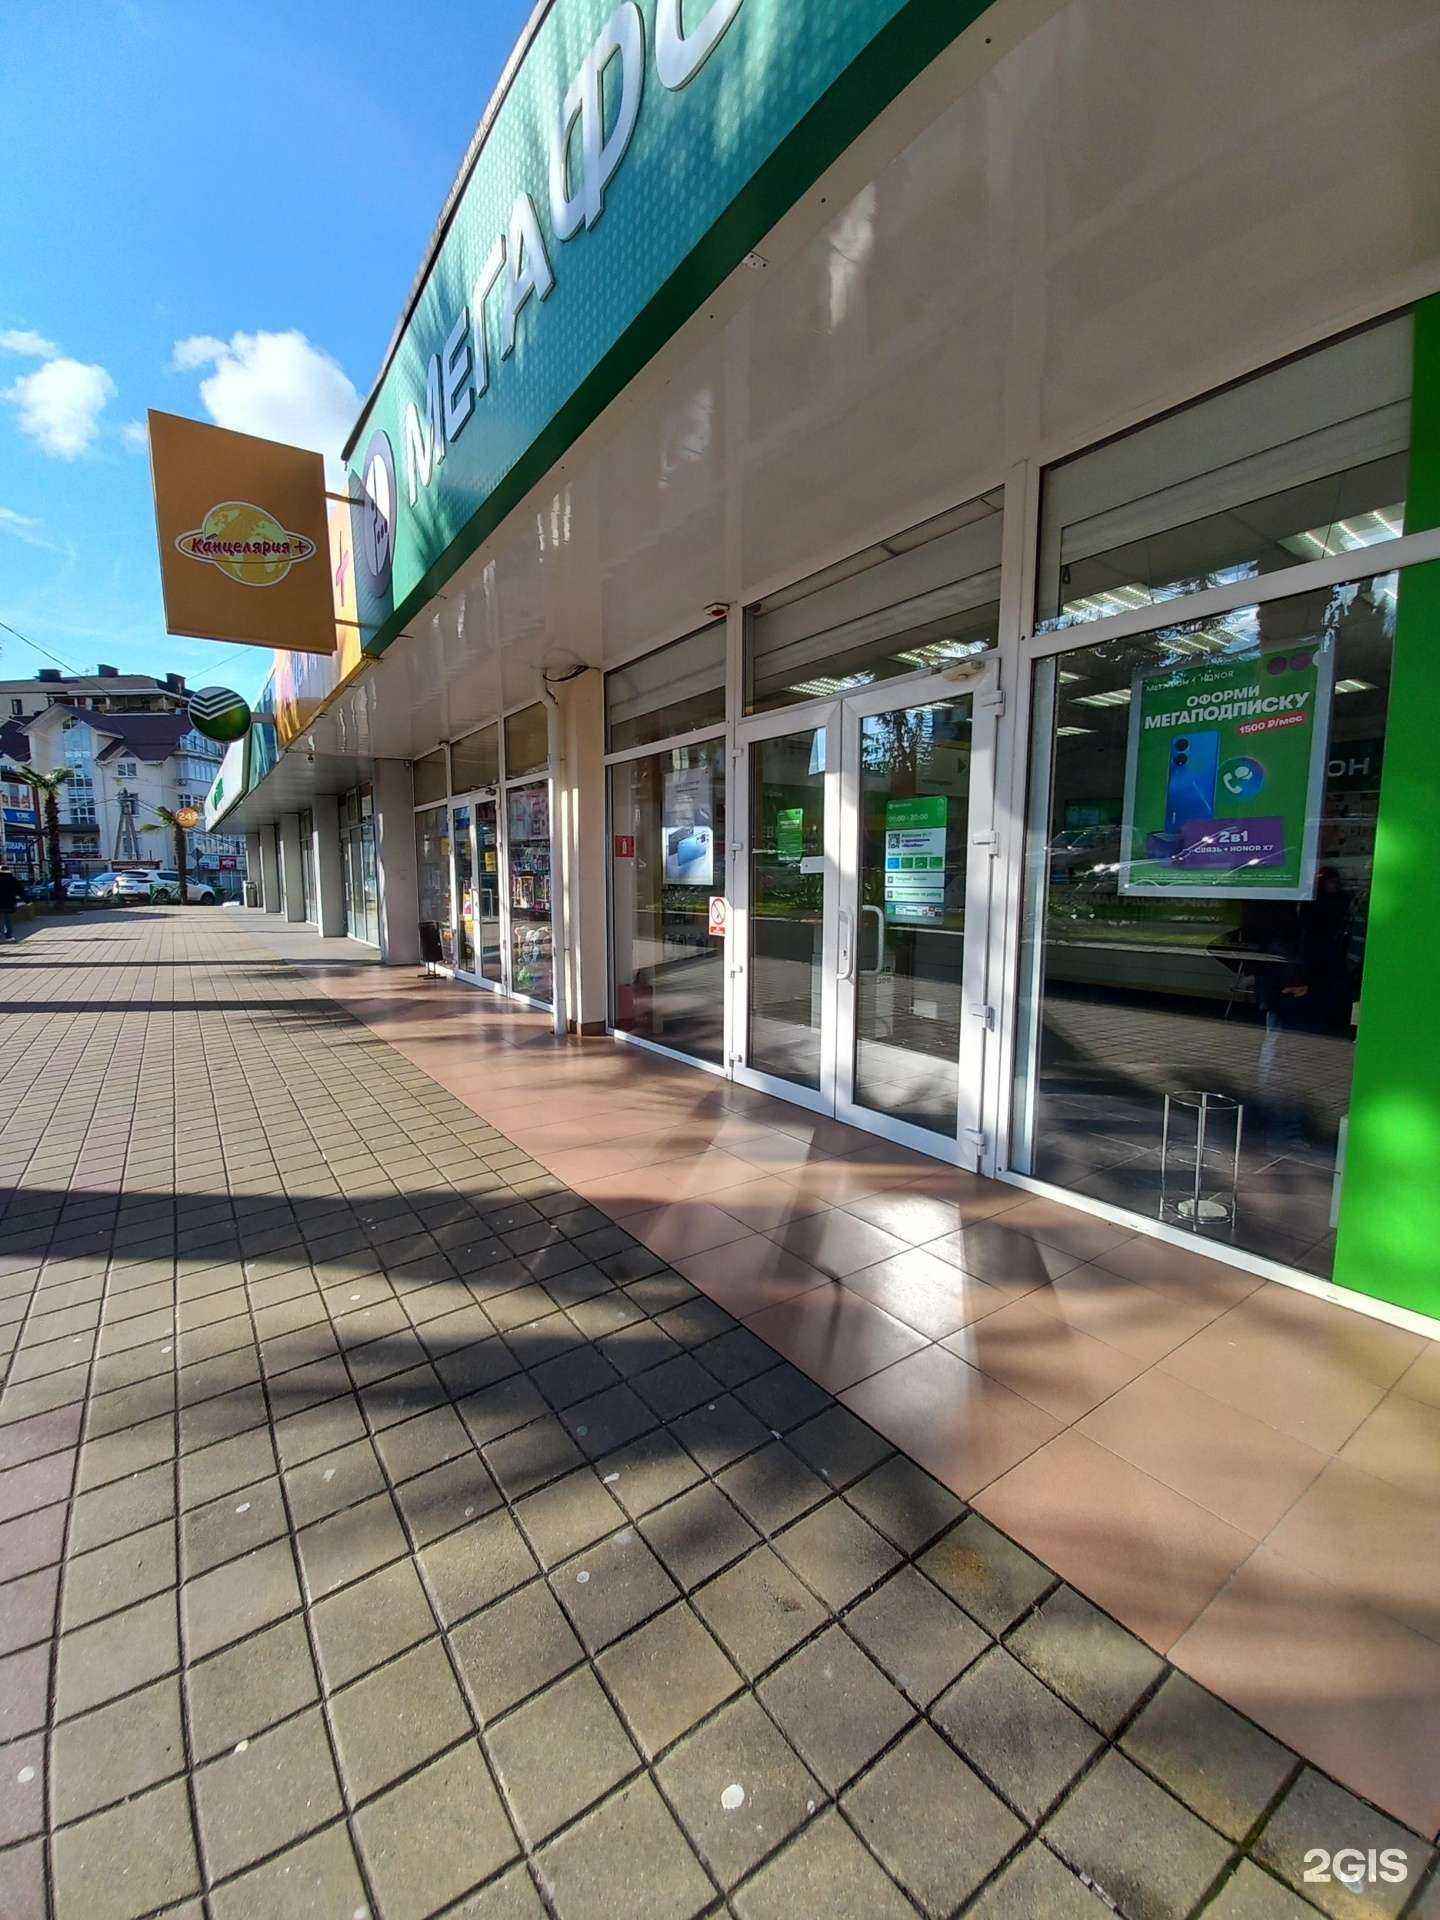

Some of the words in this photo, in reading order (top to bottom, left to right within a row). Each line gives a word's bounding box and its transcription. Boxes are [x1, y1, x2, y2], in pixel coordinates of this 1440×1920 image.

[191, 537, 290, 556] Канцелярия
[1187, 685, 1260, 707] ОФОРМИ
[1145, 692, 1311, 730] МЕГАПОДПИСКУ
